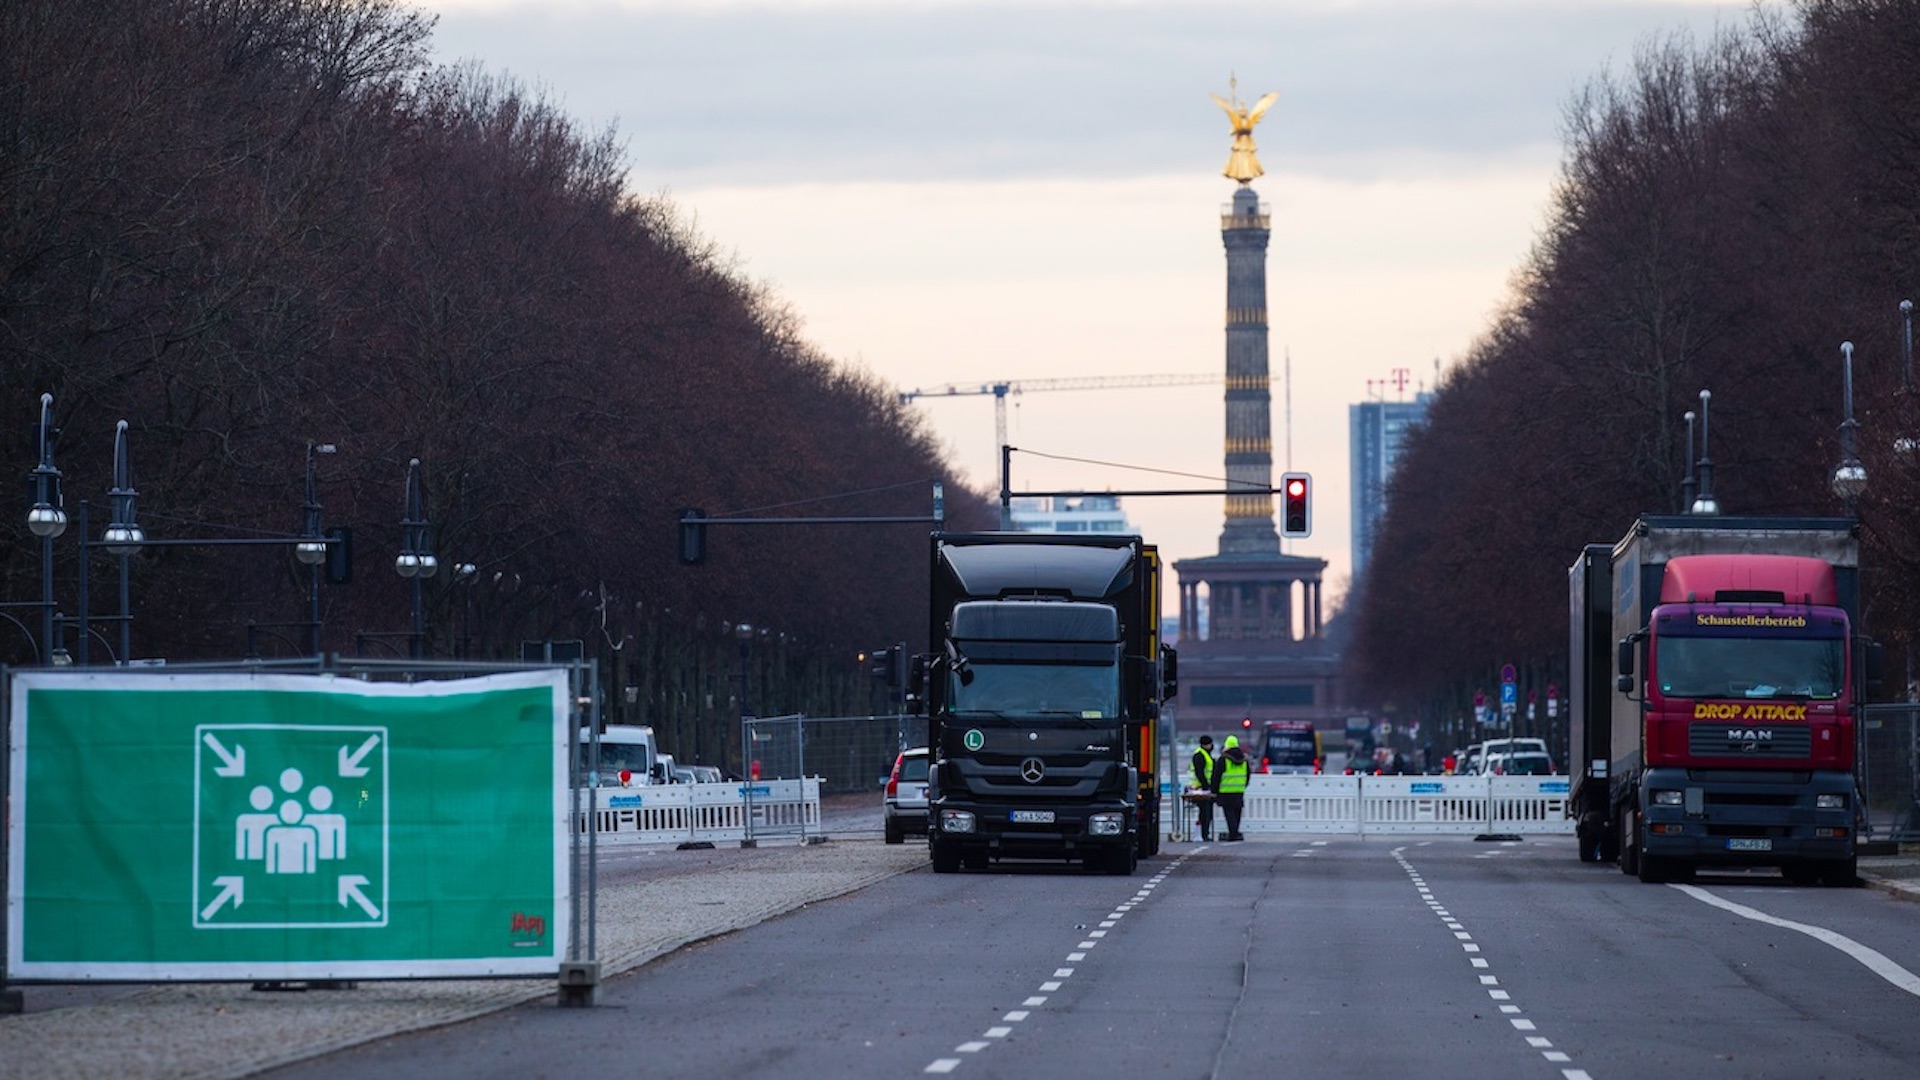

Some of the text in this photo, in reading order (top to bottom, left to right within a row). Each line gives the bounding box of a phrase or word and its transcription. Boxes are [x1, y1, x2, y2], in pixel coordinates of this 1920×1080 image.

[1696, 613, 1807, 628] Schaustellerbetrieb
[1694, 703, 1807, 721] DROP ATTACK
[1728, 729, 1773, 740] MAN
